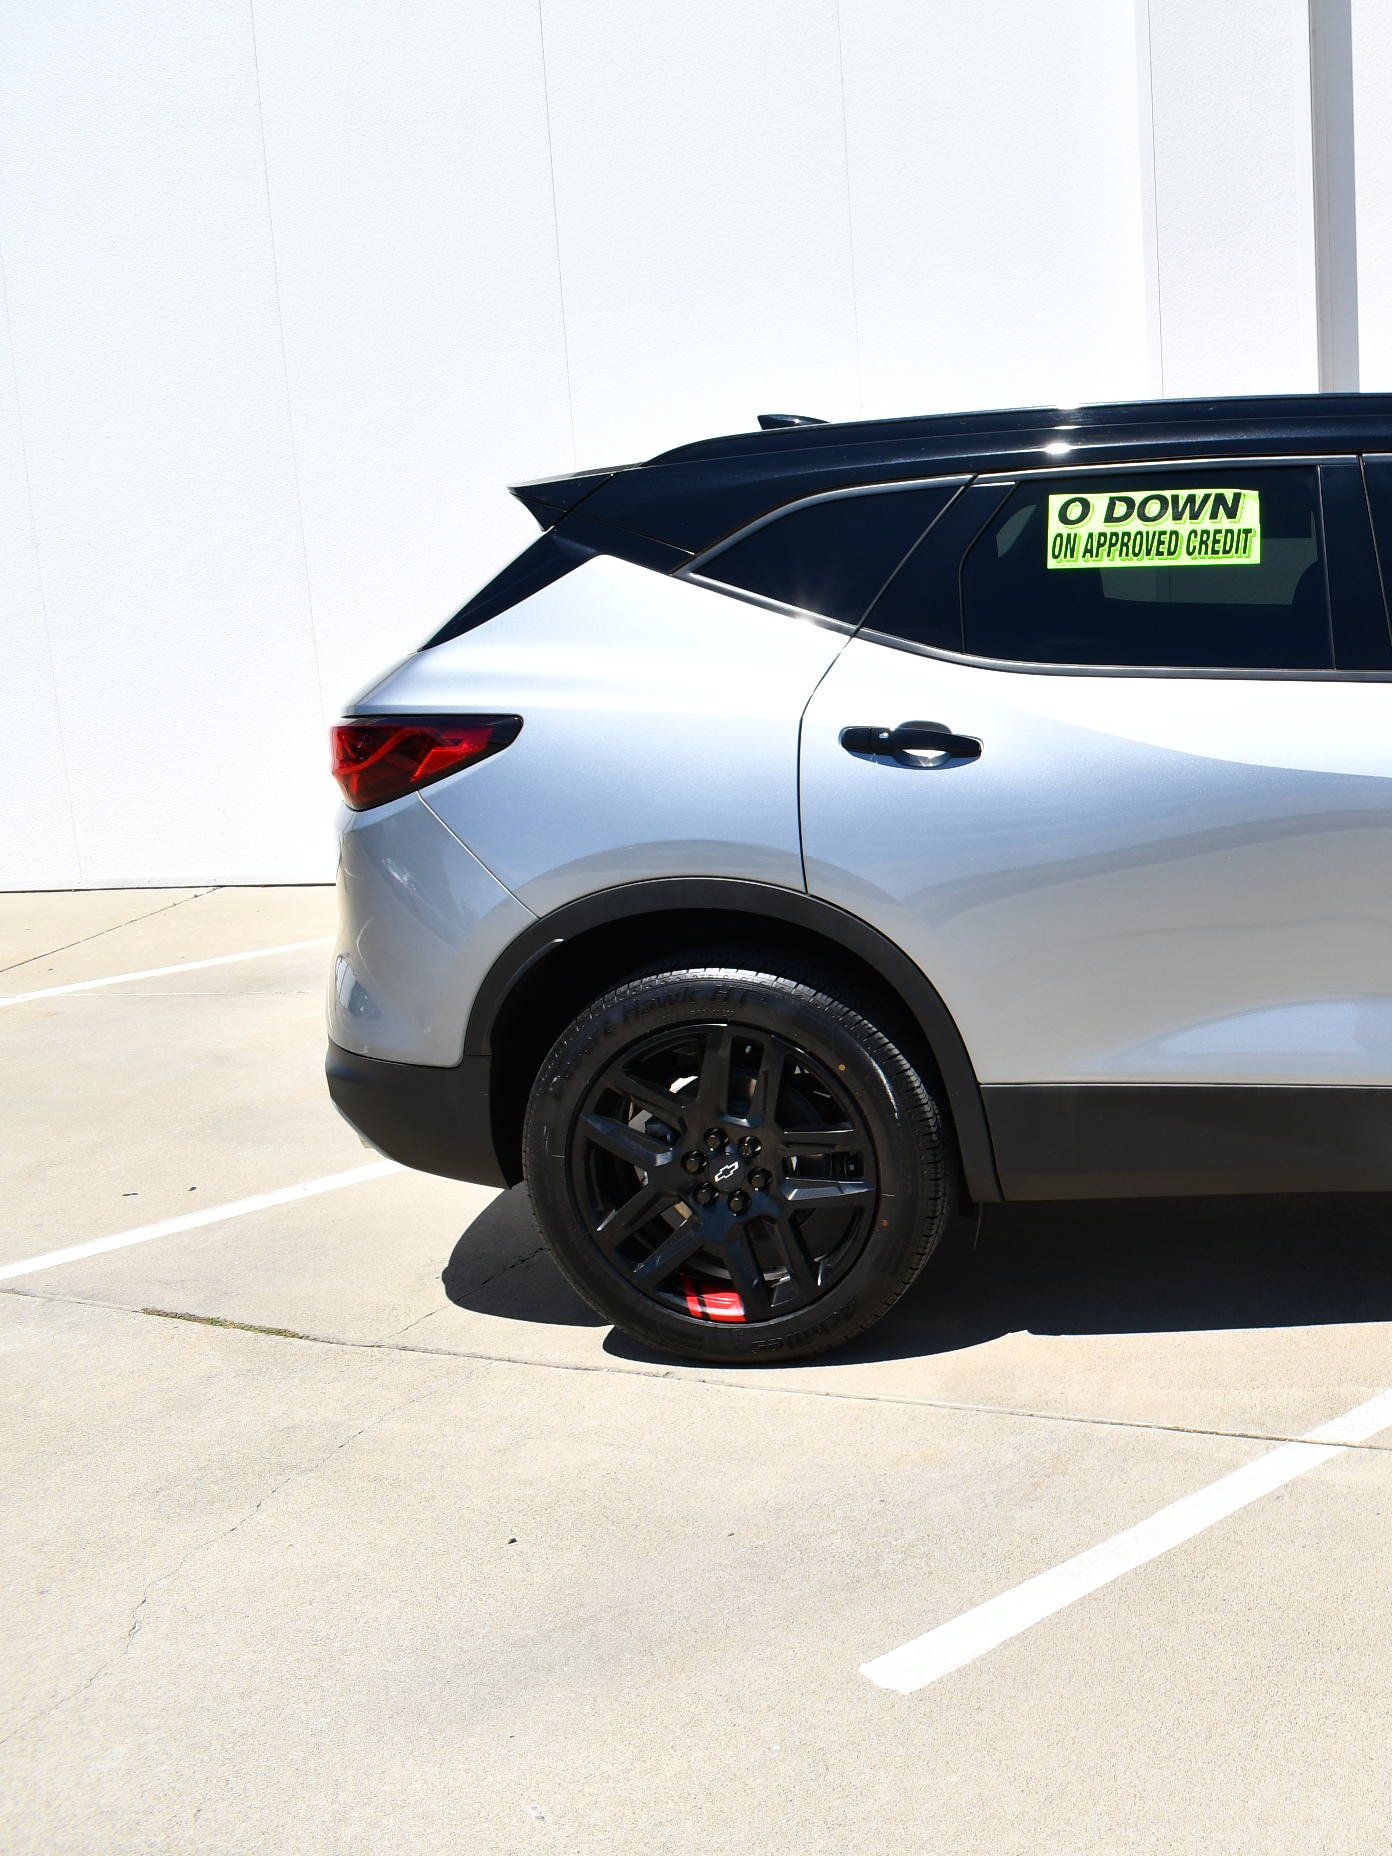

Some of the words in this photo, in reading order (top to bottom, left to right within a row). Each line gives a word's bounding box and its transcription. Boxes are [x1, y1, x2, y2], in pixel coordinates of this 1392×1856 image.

[1103, 491, 1244, 525] DOWN
[1051, 532, 1079, 560] ON
[1081, 529, 1181, 560] APPROVED
[1186, 527, 1255, 558] CREDIT
